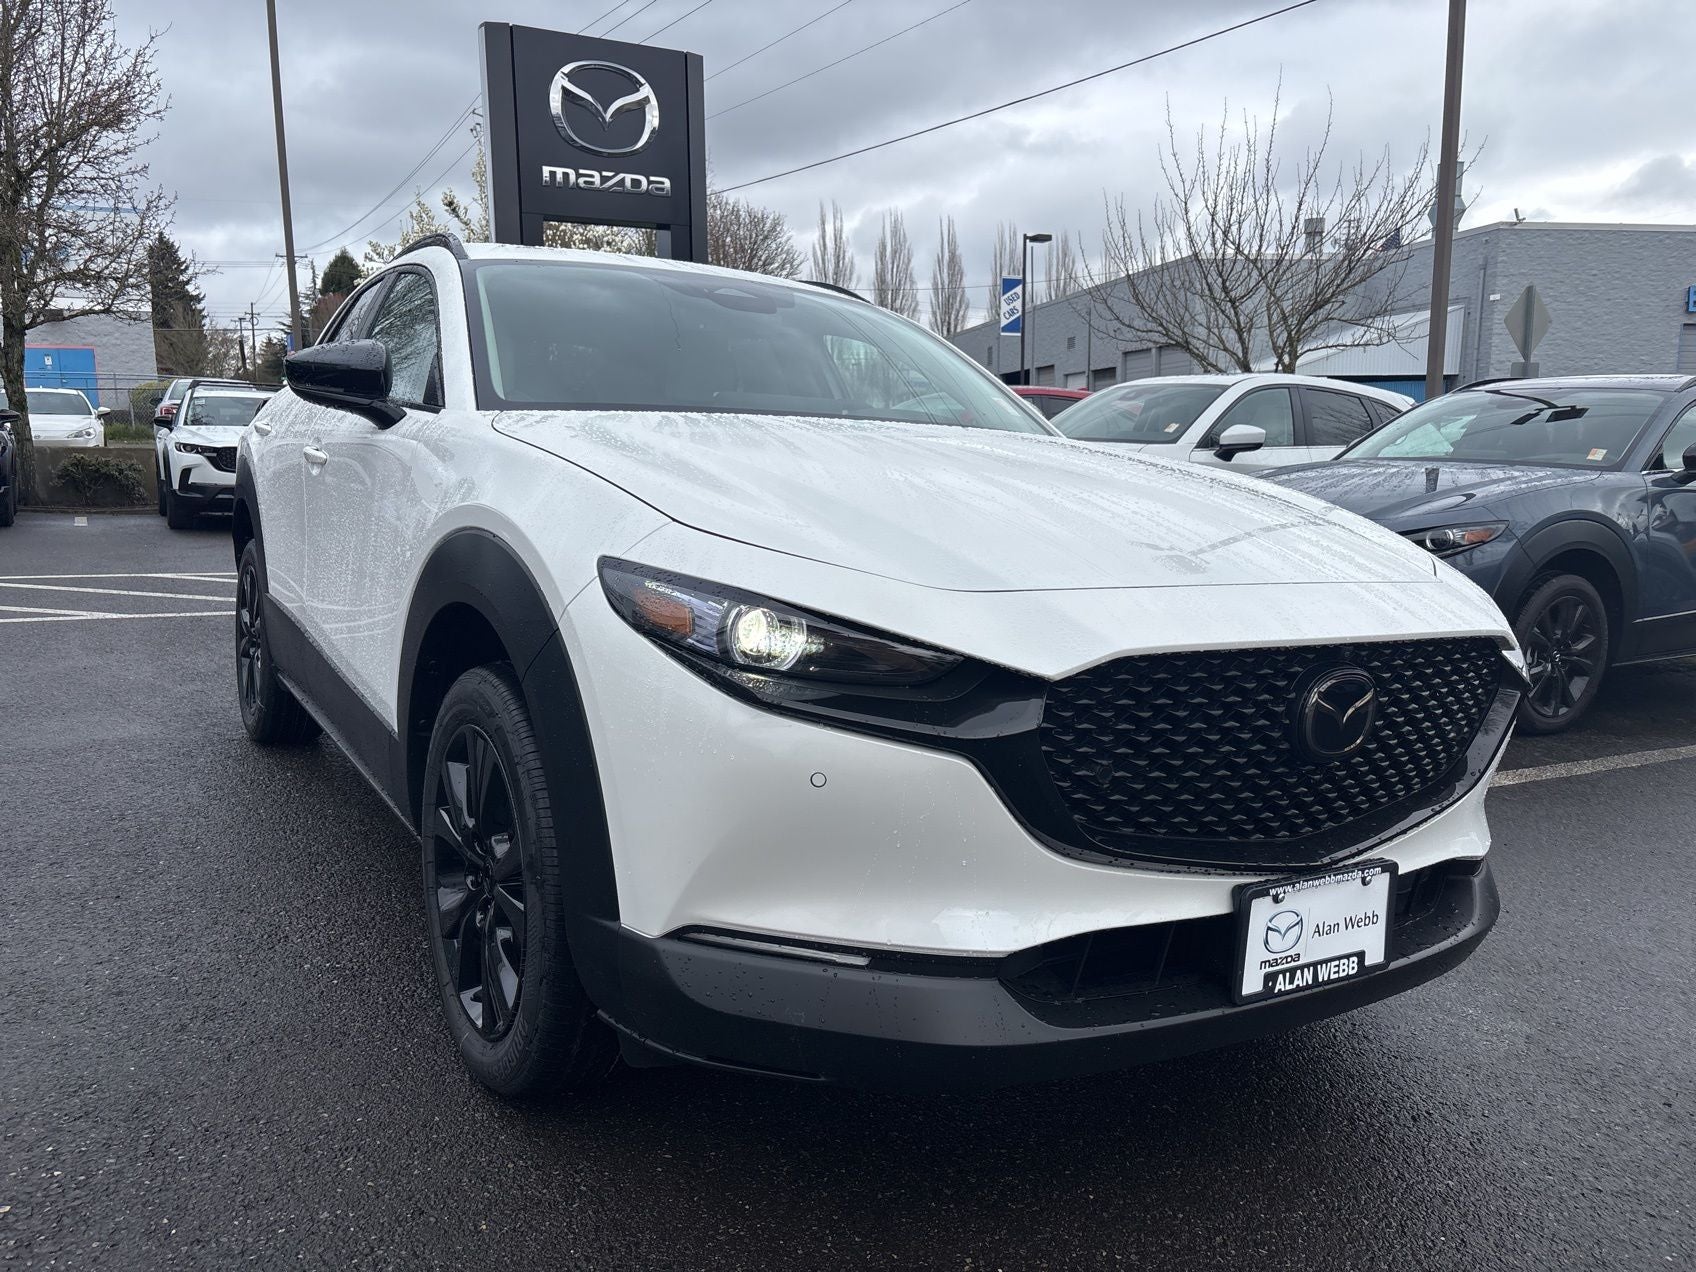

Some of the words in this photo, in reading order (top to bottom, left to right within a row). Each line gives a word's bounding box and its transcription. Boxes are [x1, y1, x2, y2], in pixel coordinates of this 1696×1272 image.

[542, 165, 672, 197] mazda
[1003, 292, 1020, 306] USED
[1003, 306, 1020, 320] CARS
[1269, 867, 1382, 896] www.alanwebbmazda.com
[1311, 920, 1340, 939] Alan
[1343, 910, 1379, 931] Webb
[1259, 952, 1301, 970] mazda
[1274, 966, 1313, 993] ALAN
[1317, 956, 1358, 982] WEBB
